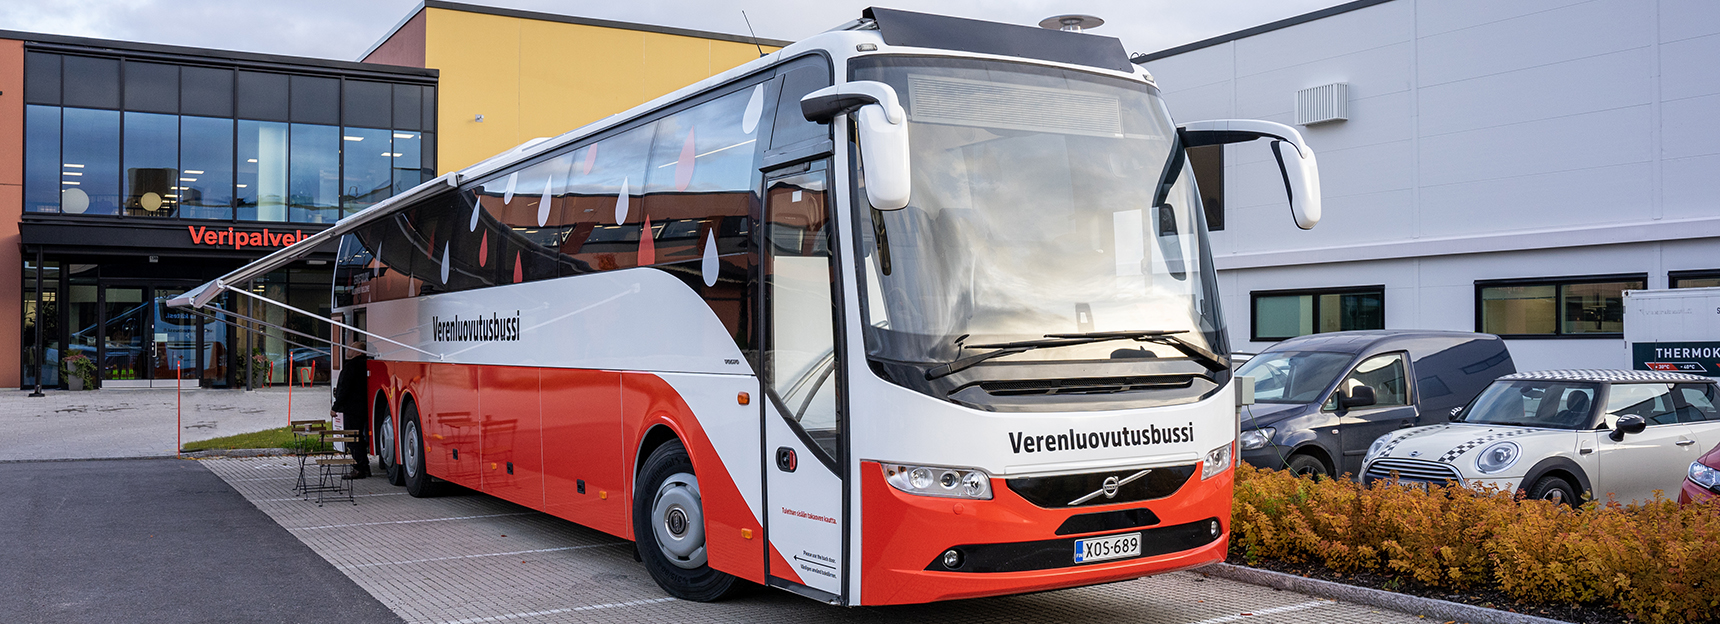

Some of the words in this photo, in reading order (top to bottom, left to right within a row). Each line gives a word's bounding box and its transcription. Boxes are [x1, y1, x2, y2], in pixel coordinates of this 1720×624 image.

[188, 225, 314, 250] Veripalvel
[432, 310, 520, 342] Verenluovutusbussi
[1655, 347, 1720, 358] THERMOK
[1008, 421, 1194, 454] Verenluovutusbussi
[1085, 537, 1138, 558] XOS-689
